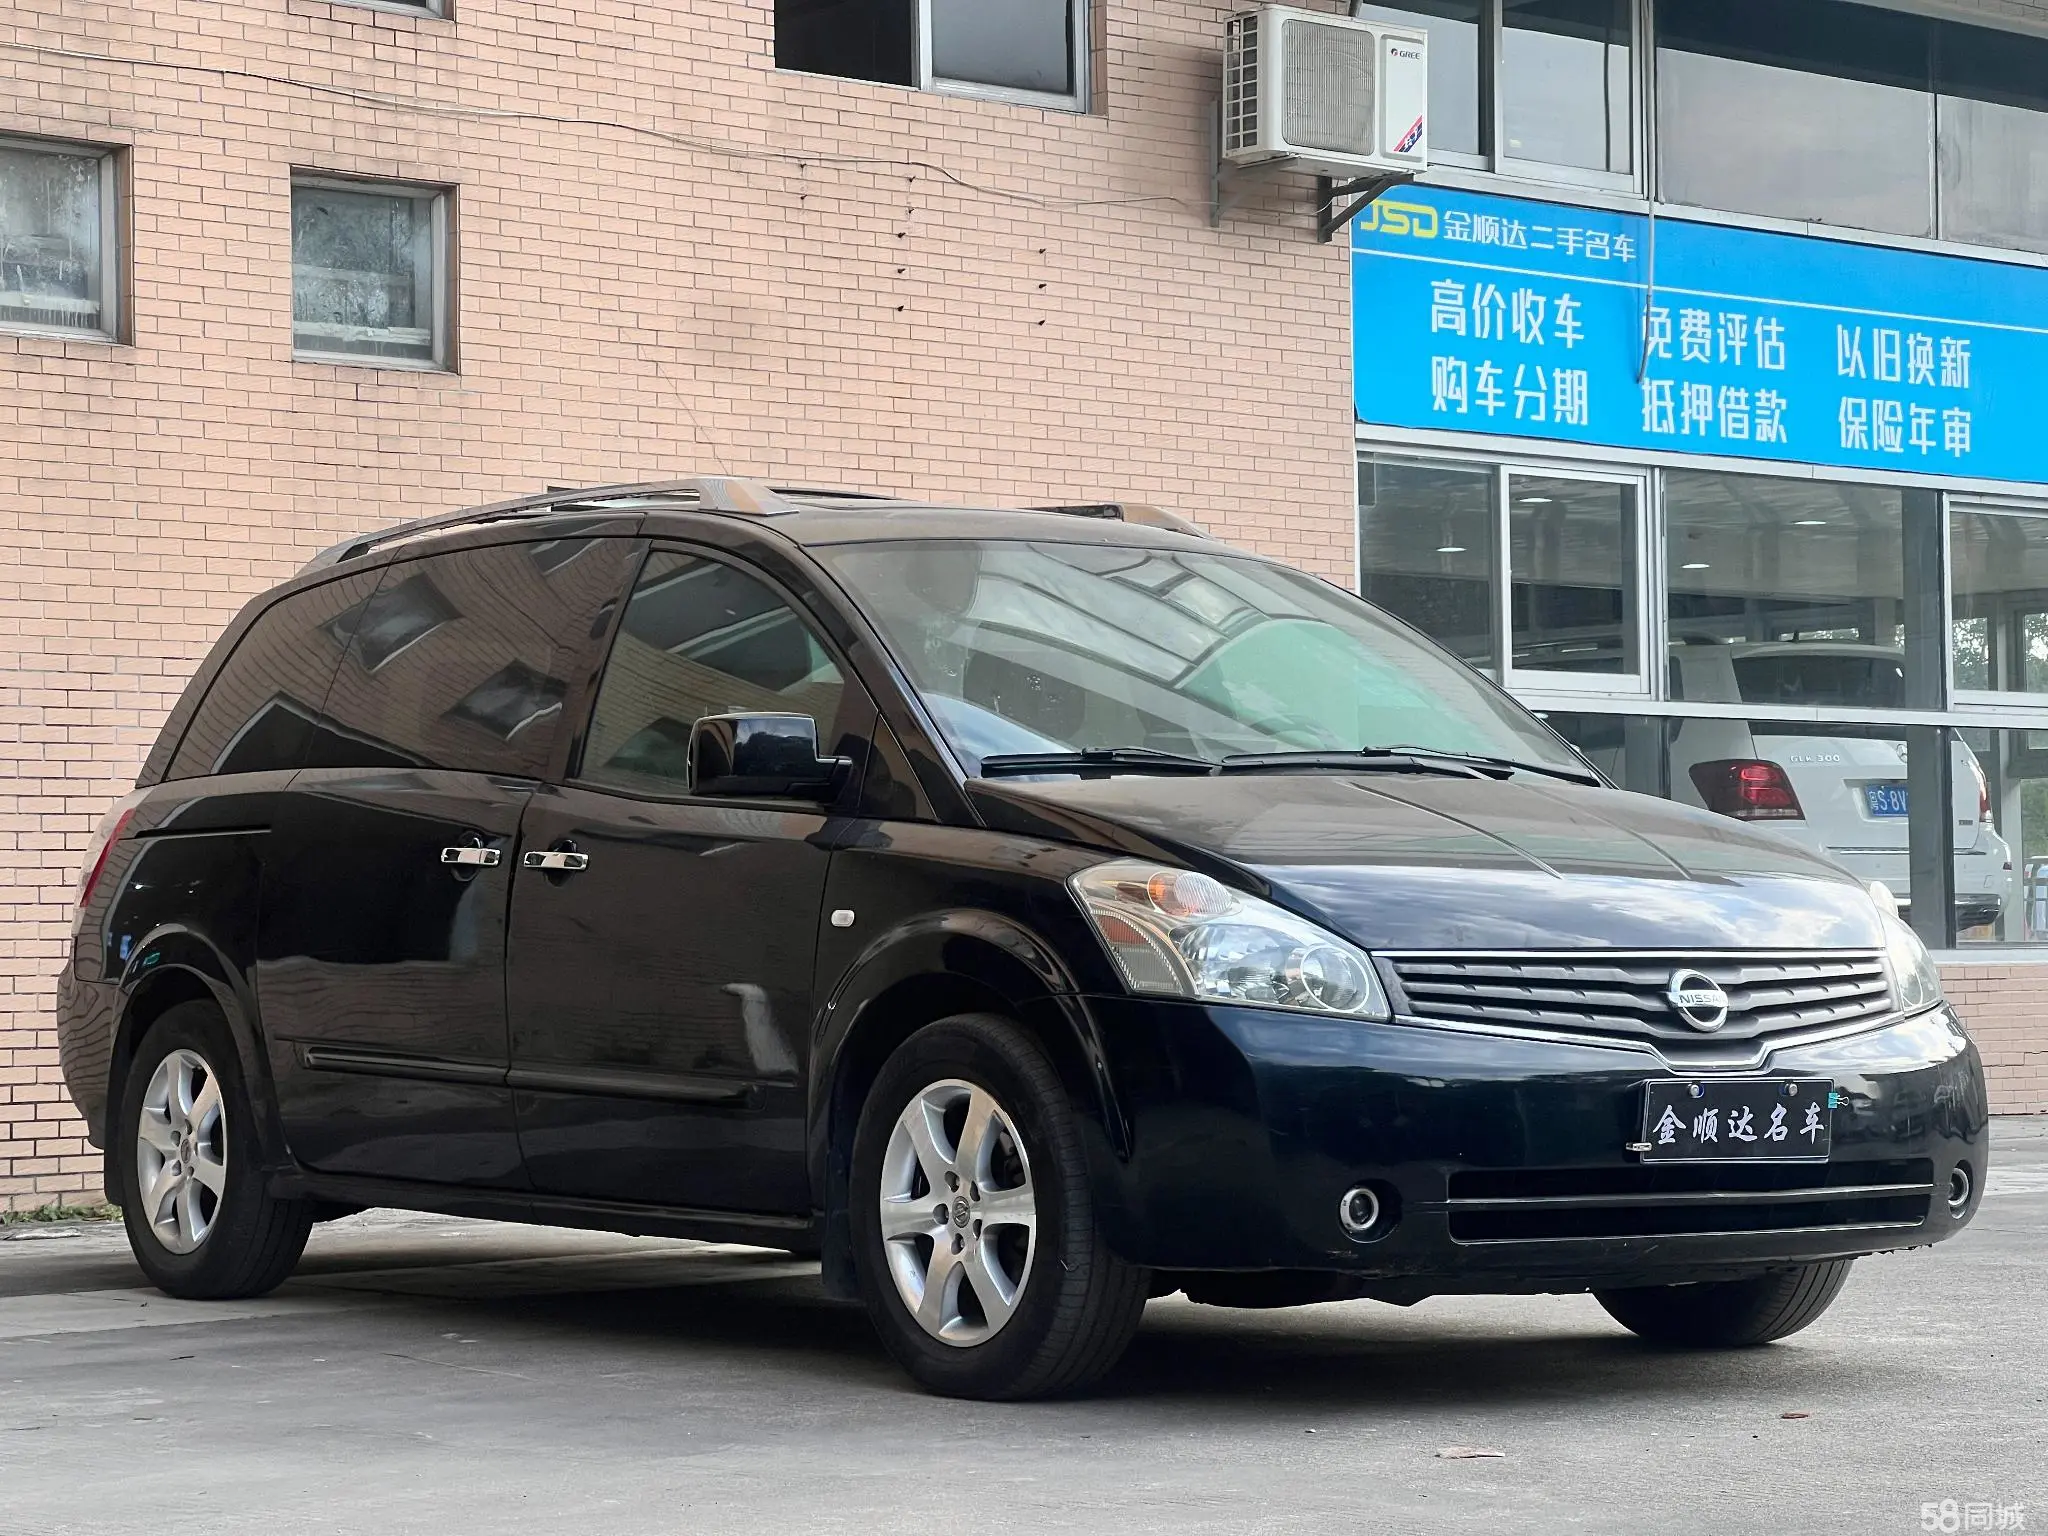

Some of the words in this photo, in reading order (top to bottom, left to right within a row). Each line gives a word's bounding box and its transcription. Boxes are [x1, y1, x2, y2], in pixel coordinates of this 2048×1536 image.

[1399, 50, 1421, 60] GREE
[1361, 200, 1438, 238] JSD
[1443, 210, 1637, 263] 金顺达二手名车
[1430, 278, 1585, 349] 高价收车
[1642, 304, 1785, 371] 免费评估
[1836, 323, 1971, 389] 以旧换新
[1431, 355, 1588, 426] 购车分期
[1641, 378, 1788, 443] 抵押借款
[1838, 396, 1971, 458] 保险年审
[1790, 755, 1813, 763] GLK
[1817, 754, 1841, 763] 300
[1653, 1102, 1825, 1145] 金顺达名车
